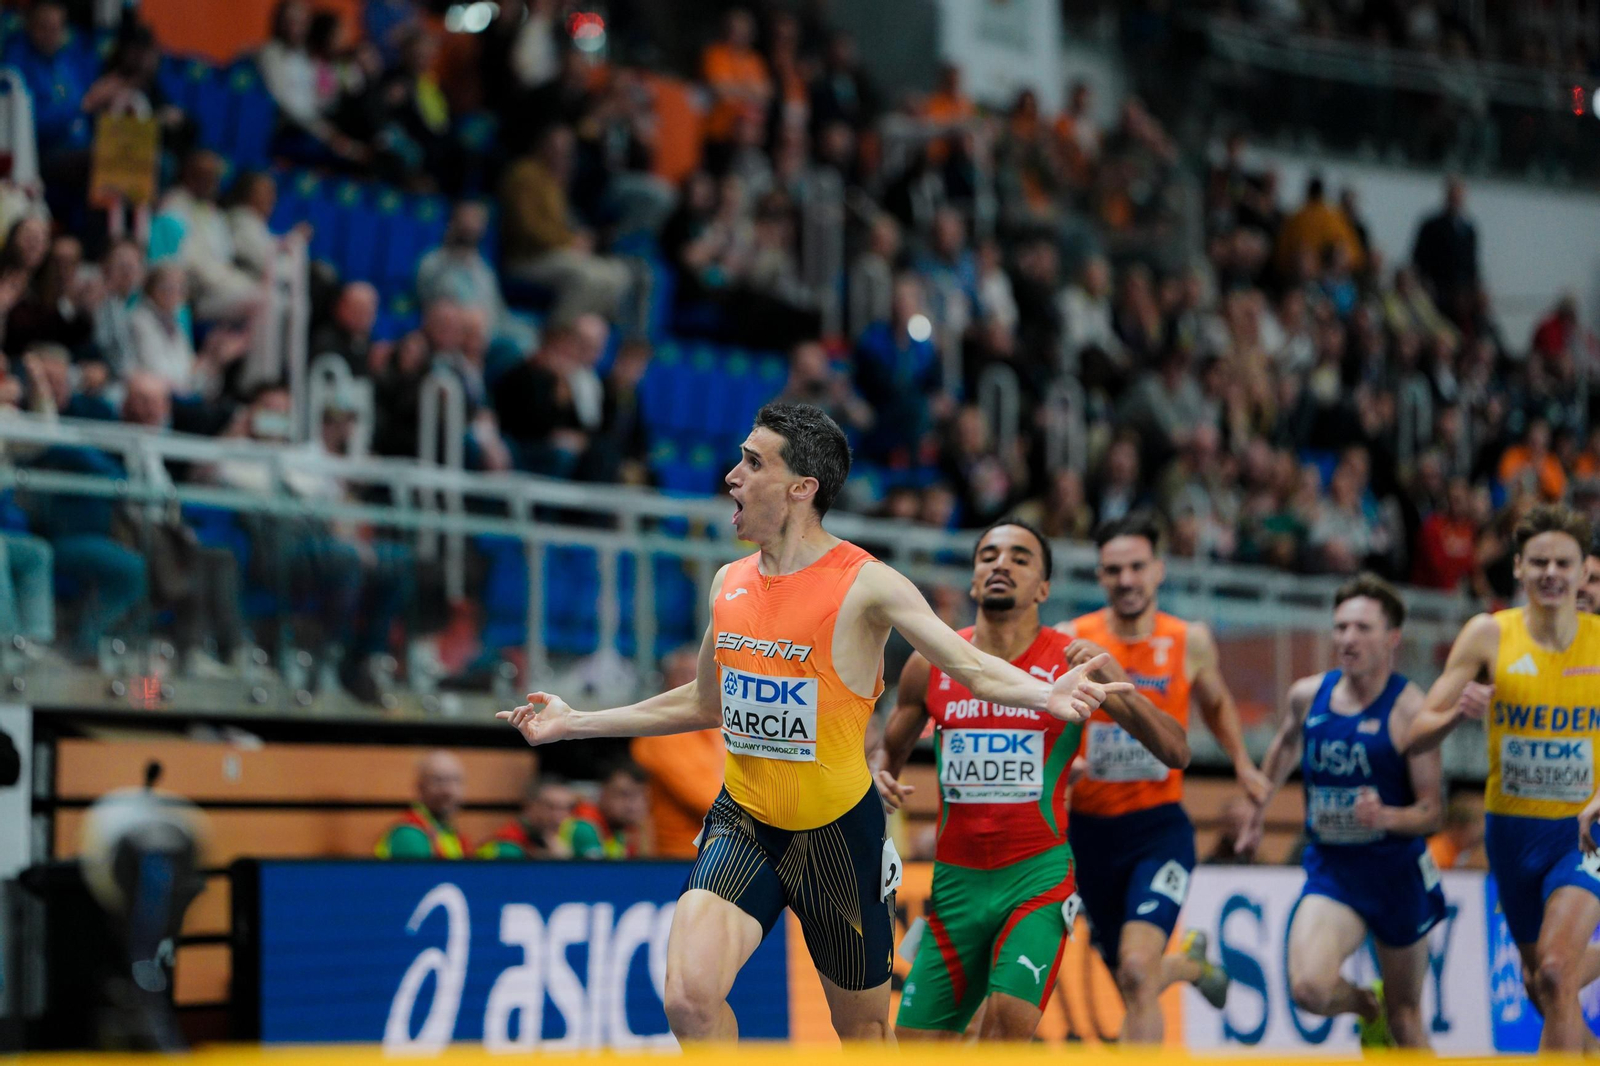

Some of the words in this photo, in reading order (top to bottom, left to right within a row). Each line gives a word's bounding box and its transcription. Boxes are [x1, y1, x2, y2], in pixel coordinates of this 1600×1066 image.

[716, 632, 812, 662] ESPAÑA
[738, 674, 808, 706] TDK
[724, 705, 809, 740] GARCÍA
[732, 740, 760, 751] KUJAWY
[762, 745, 799, 755] POMORZE
[800, 748, 811, 756] 26
[965, 733, 1035, 755] TDK
[1526, 742, 1586, 760] TDK
[947, 760, 1035, 782] NADER
[1307, 738, 1373, 778] USA
